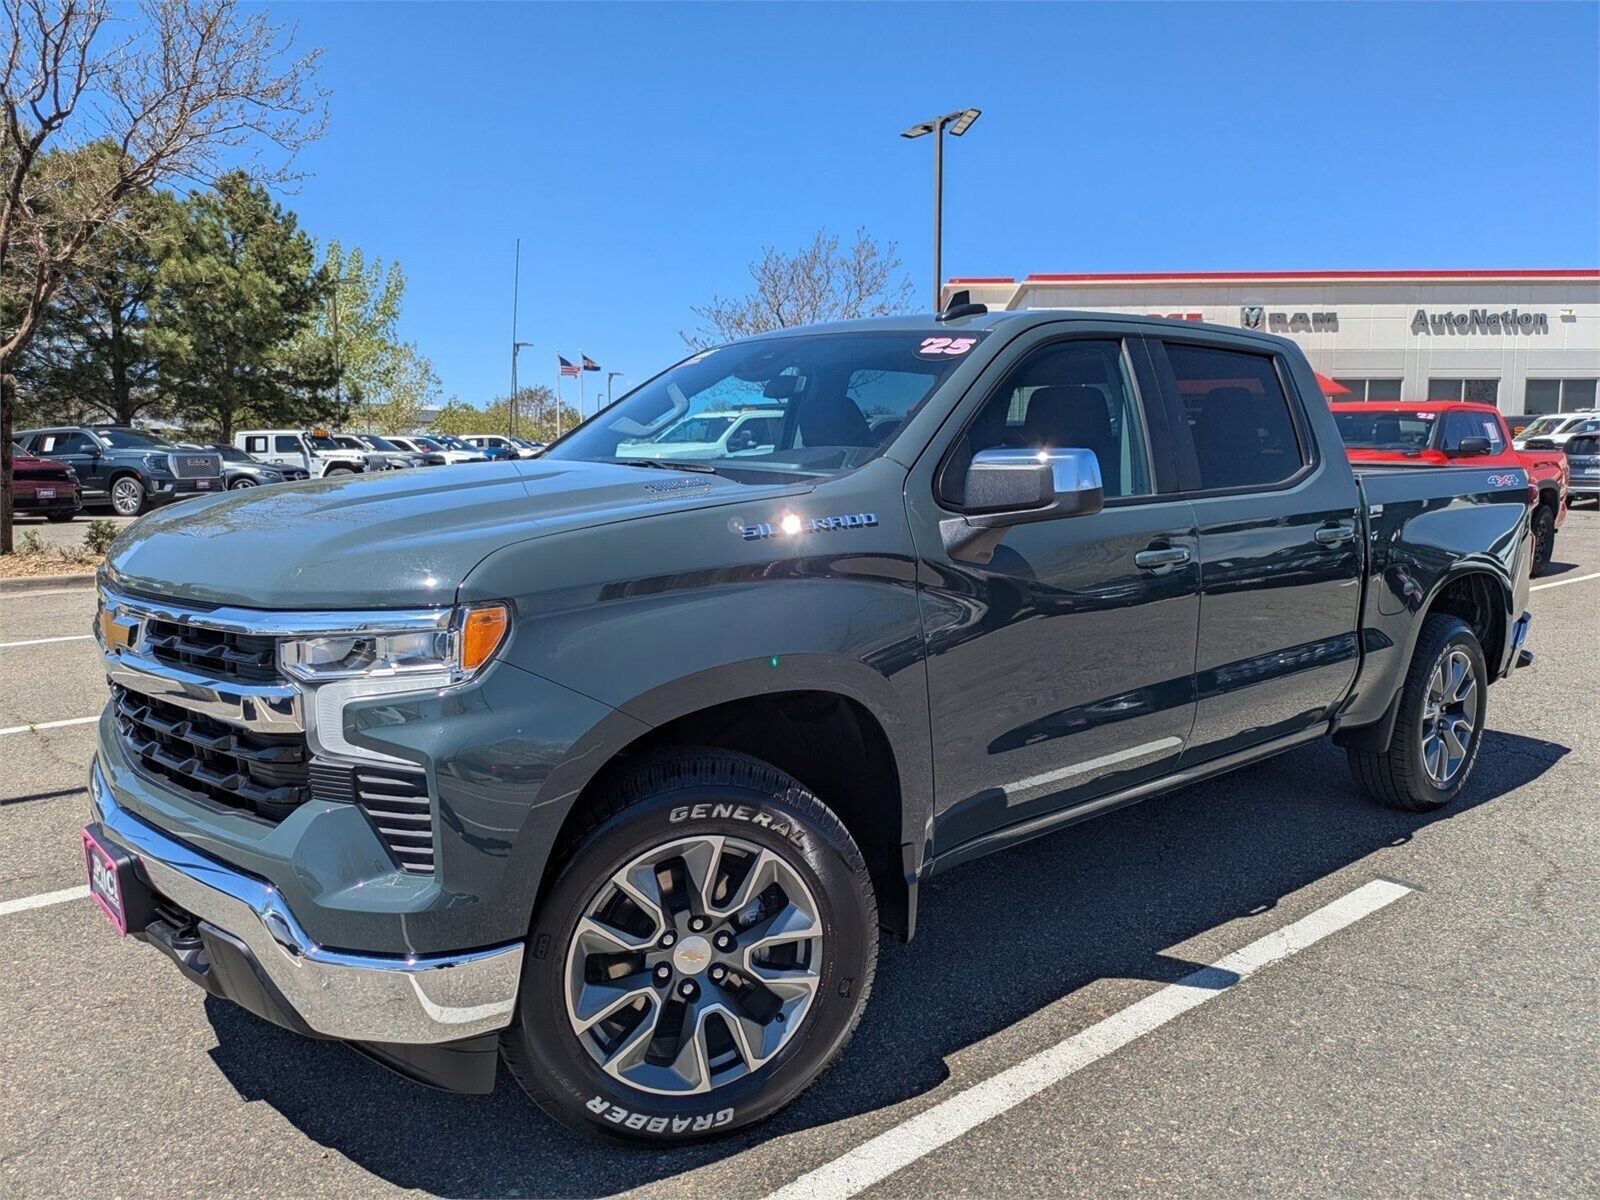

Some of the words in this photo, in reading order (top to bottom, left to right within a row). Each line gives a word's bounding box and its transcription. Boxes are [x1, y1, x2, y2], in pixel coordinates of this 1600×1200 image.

[1269, 312, 1338, 328] RAM
[1411, 308, 1549, 328] AutoNation
[740, 513, 879, 540] SILRADO
[669, 803, 805, 850] GENERAL
[585, 1095, 735, 1133] GRABBER
